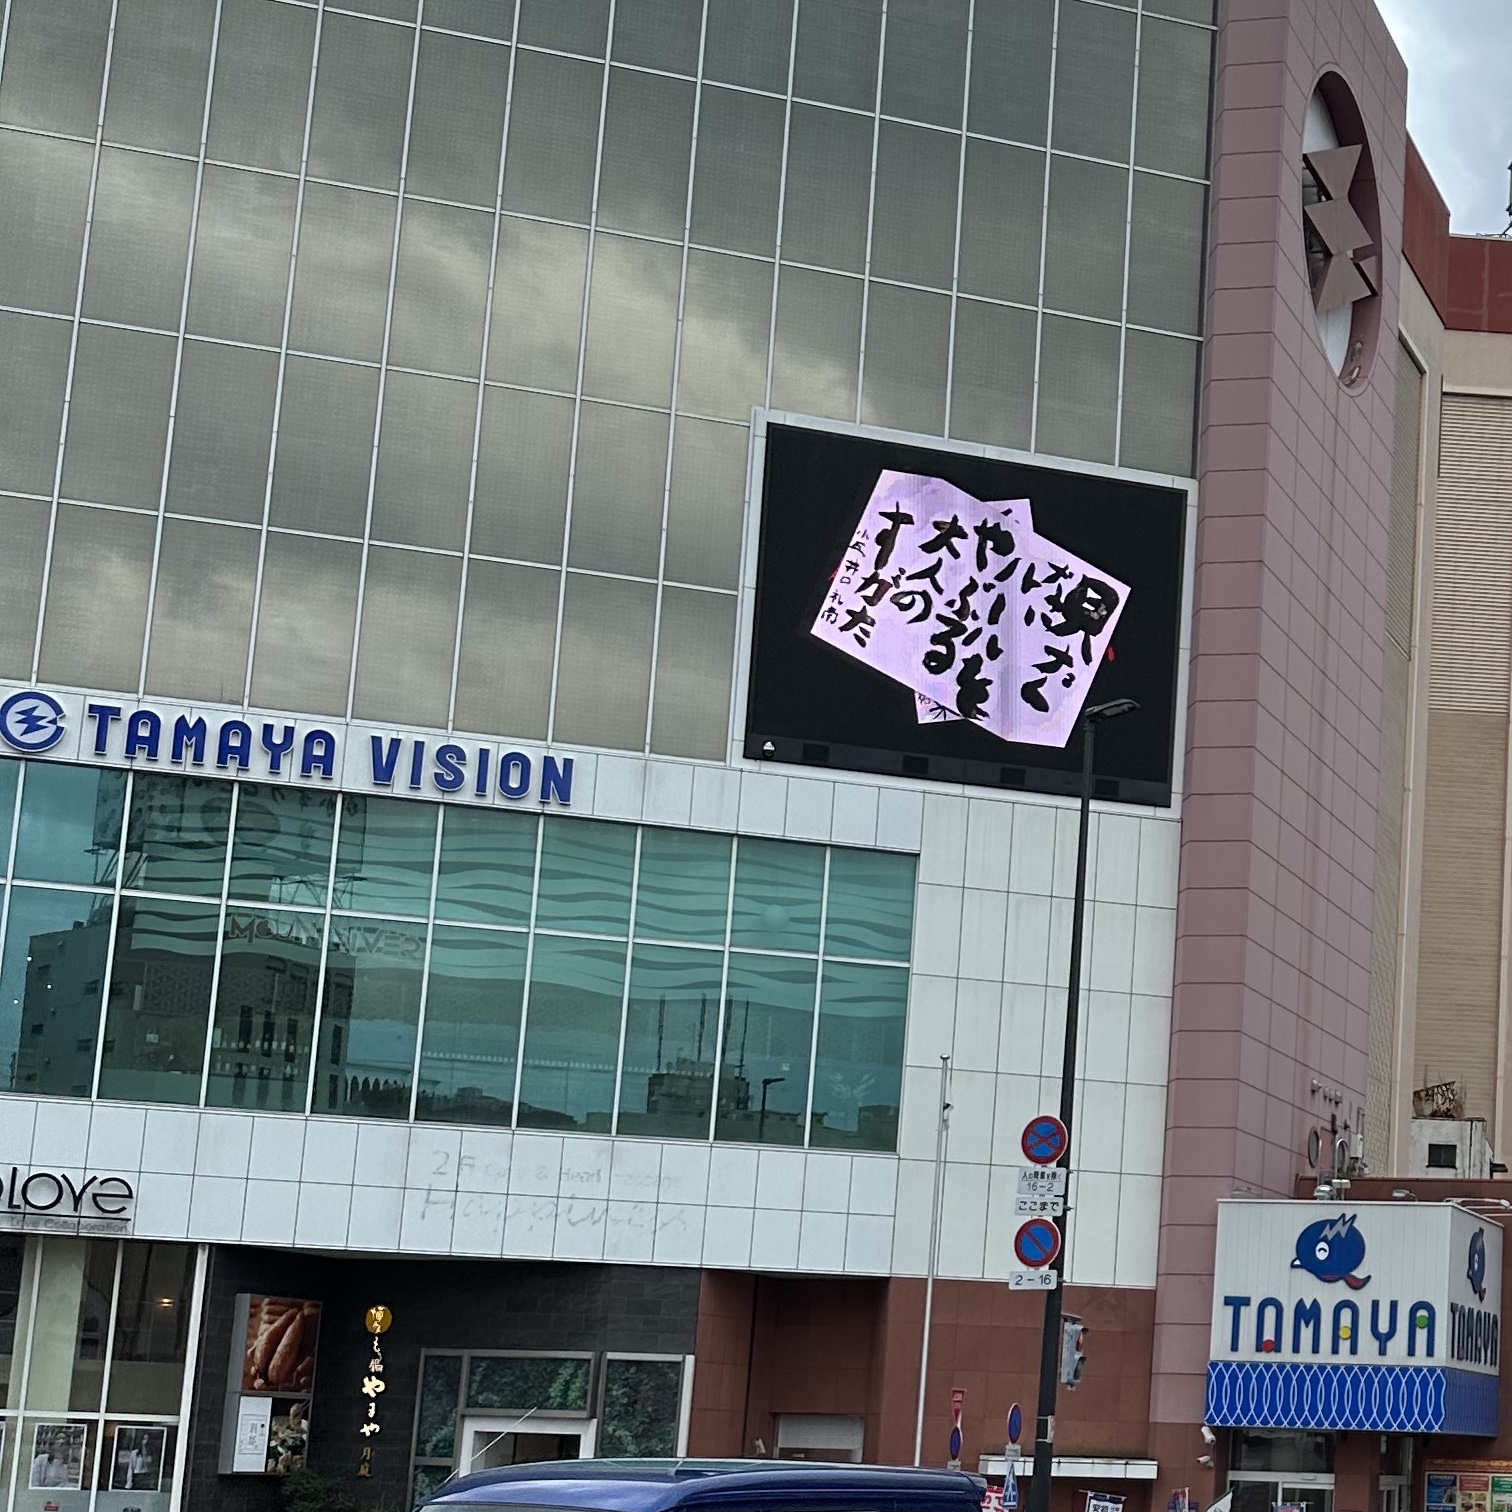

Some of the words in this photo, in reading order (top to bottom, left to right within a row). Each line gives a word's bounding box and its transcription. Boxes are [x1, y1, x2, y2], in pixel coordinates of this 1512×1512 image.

[839, 501, 915, 647] すがた
[890, 514, 969, 624] 大人の
[88, 703, 336, 780] TAMAYA
[370, 734, 574, 805] VISION
[1018, 1201, 1060, 1212] ここまで
[1026, 1182, 1054, 1193] 16-2
[1223, 1295, 1437, 1357] TAMAYA
[1450, 1301, 1499, 1368] TAMAYA
[360, 1375, 386, 1437] やまや
